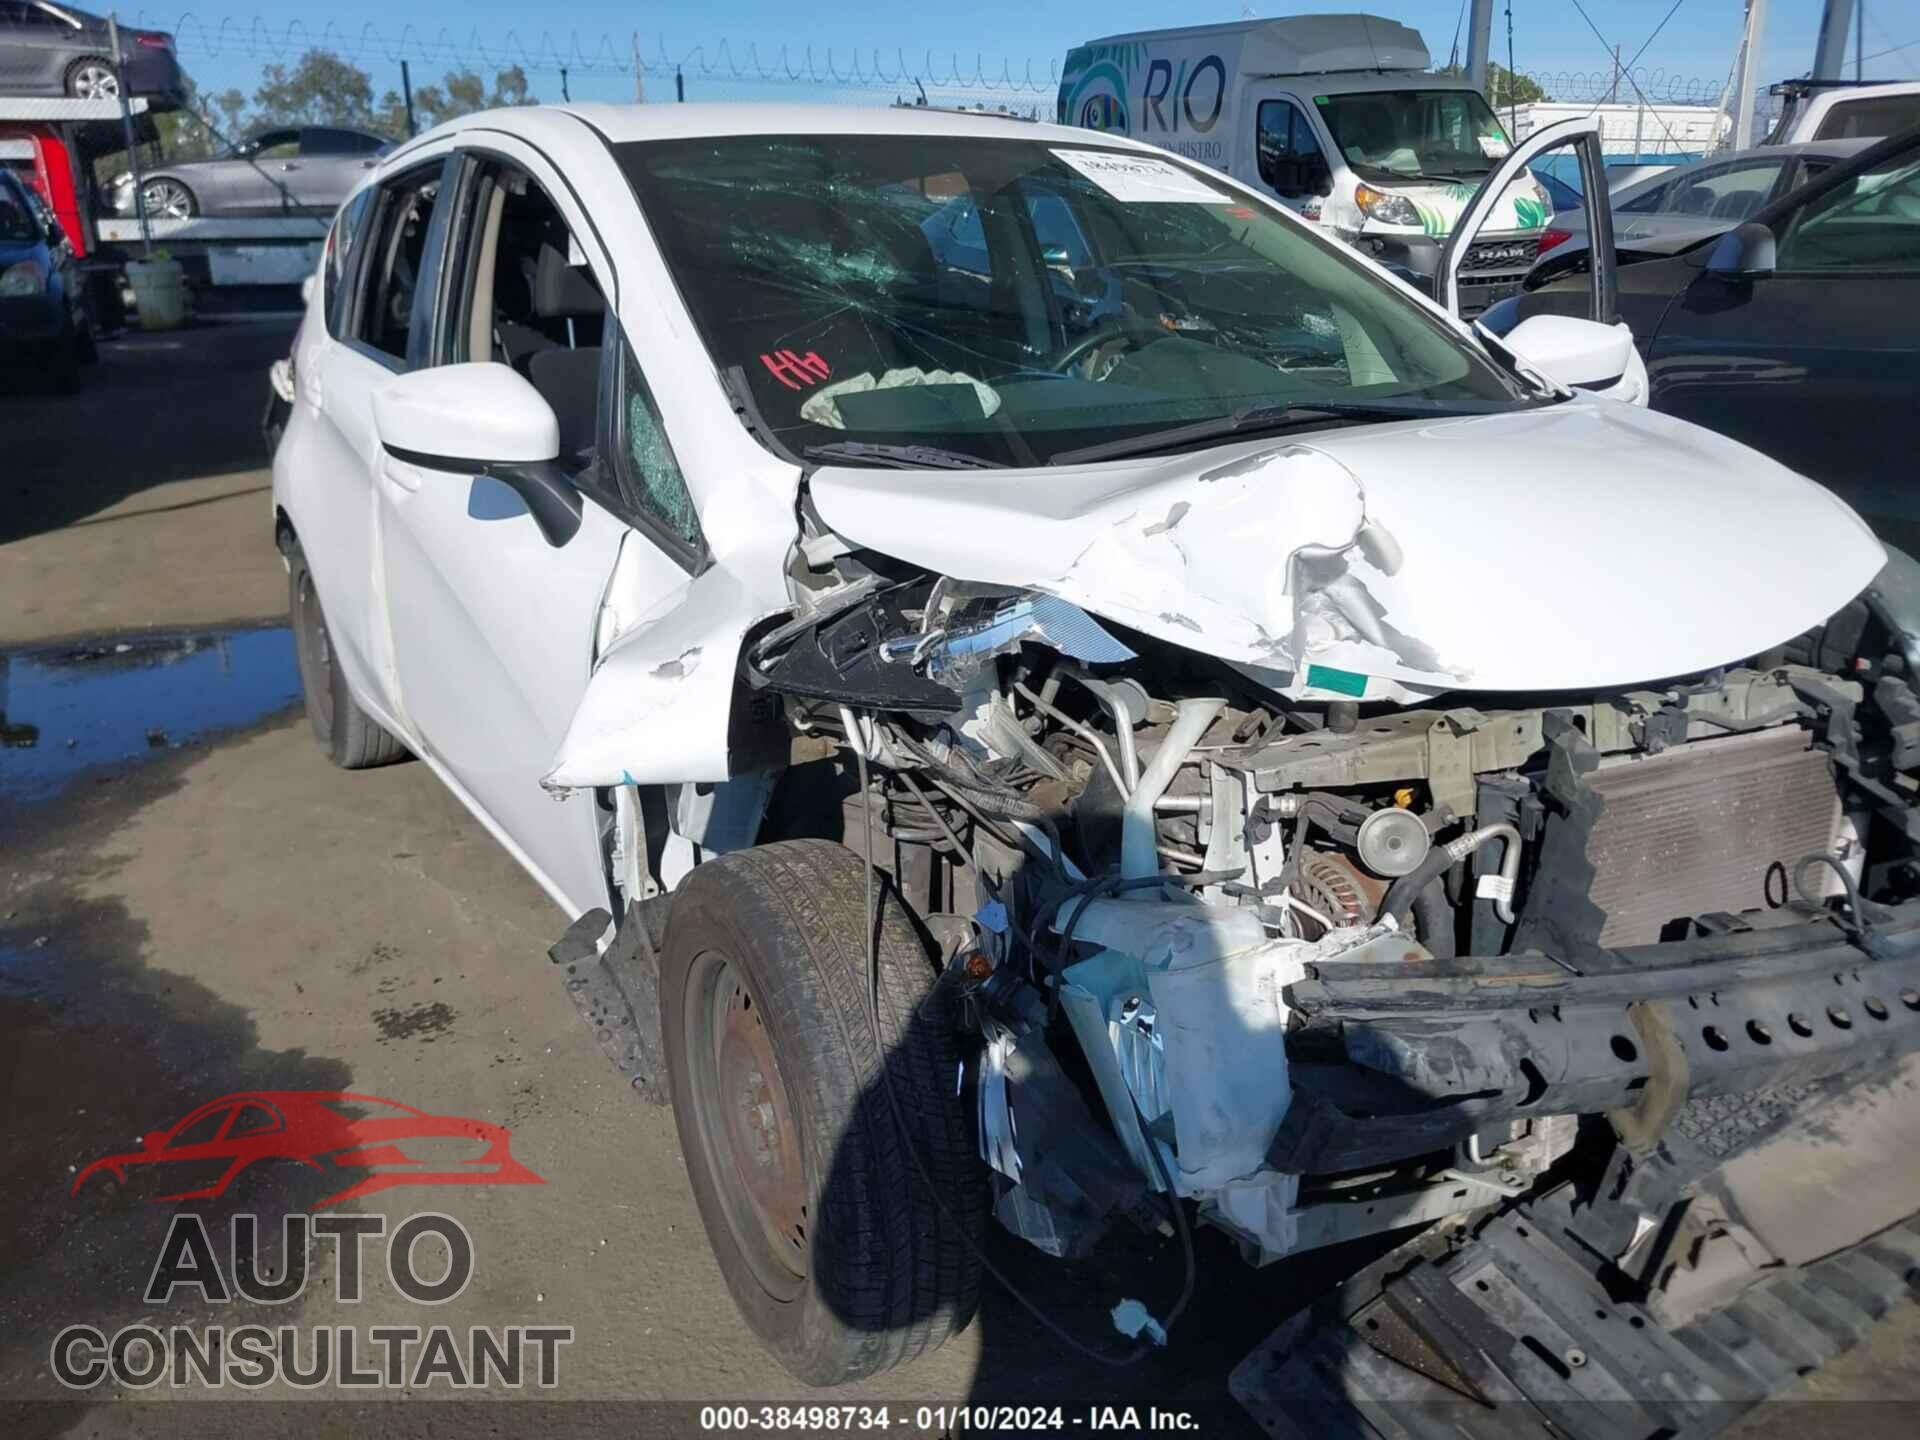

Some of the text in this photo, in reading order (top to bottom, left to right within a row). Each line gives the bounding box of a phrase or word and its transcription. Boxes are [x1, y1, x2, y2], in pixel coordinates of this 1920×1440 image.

[1143, 54, 1226, 133] RIO
[1179, 140, 1224, 160] BISTRO
[1479, 247, 1525, 260] RAM
